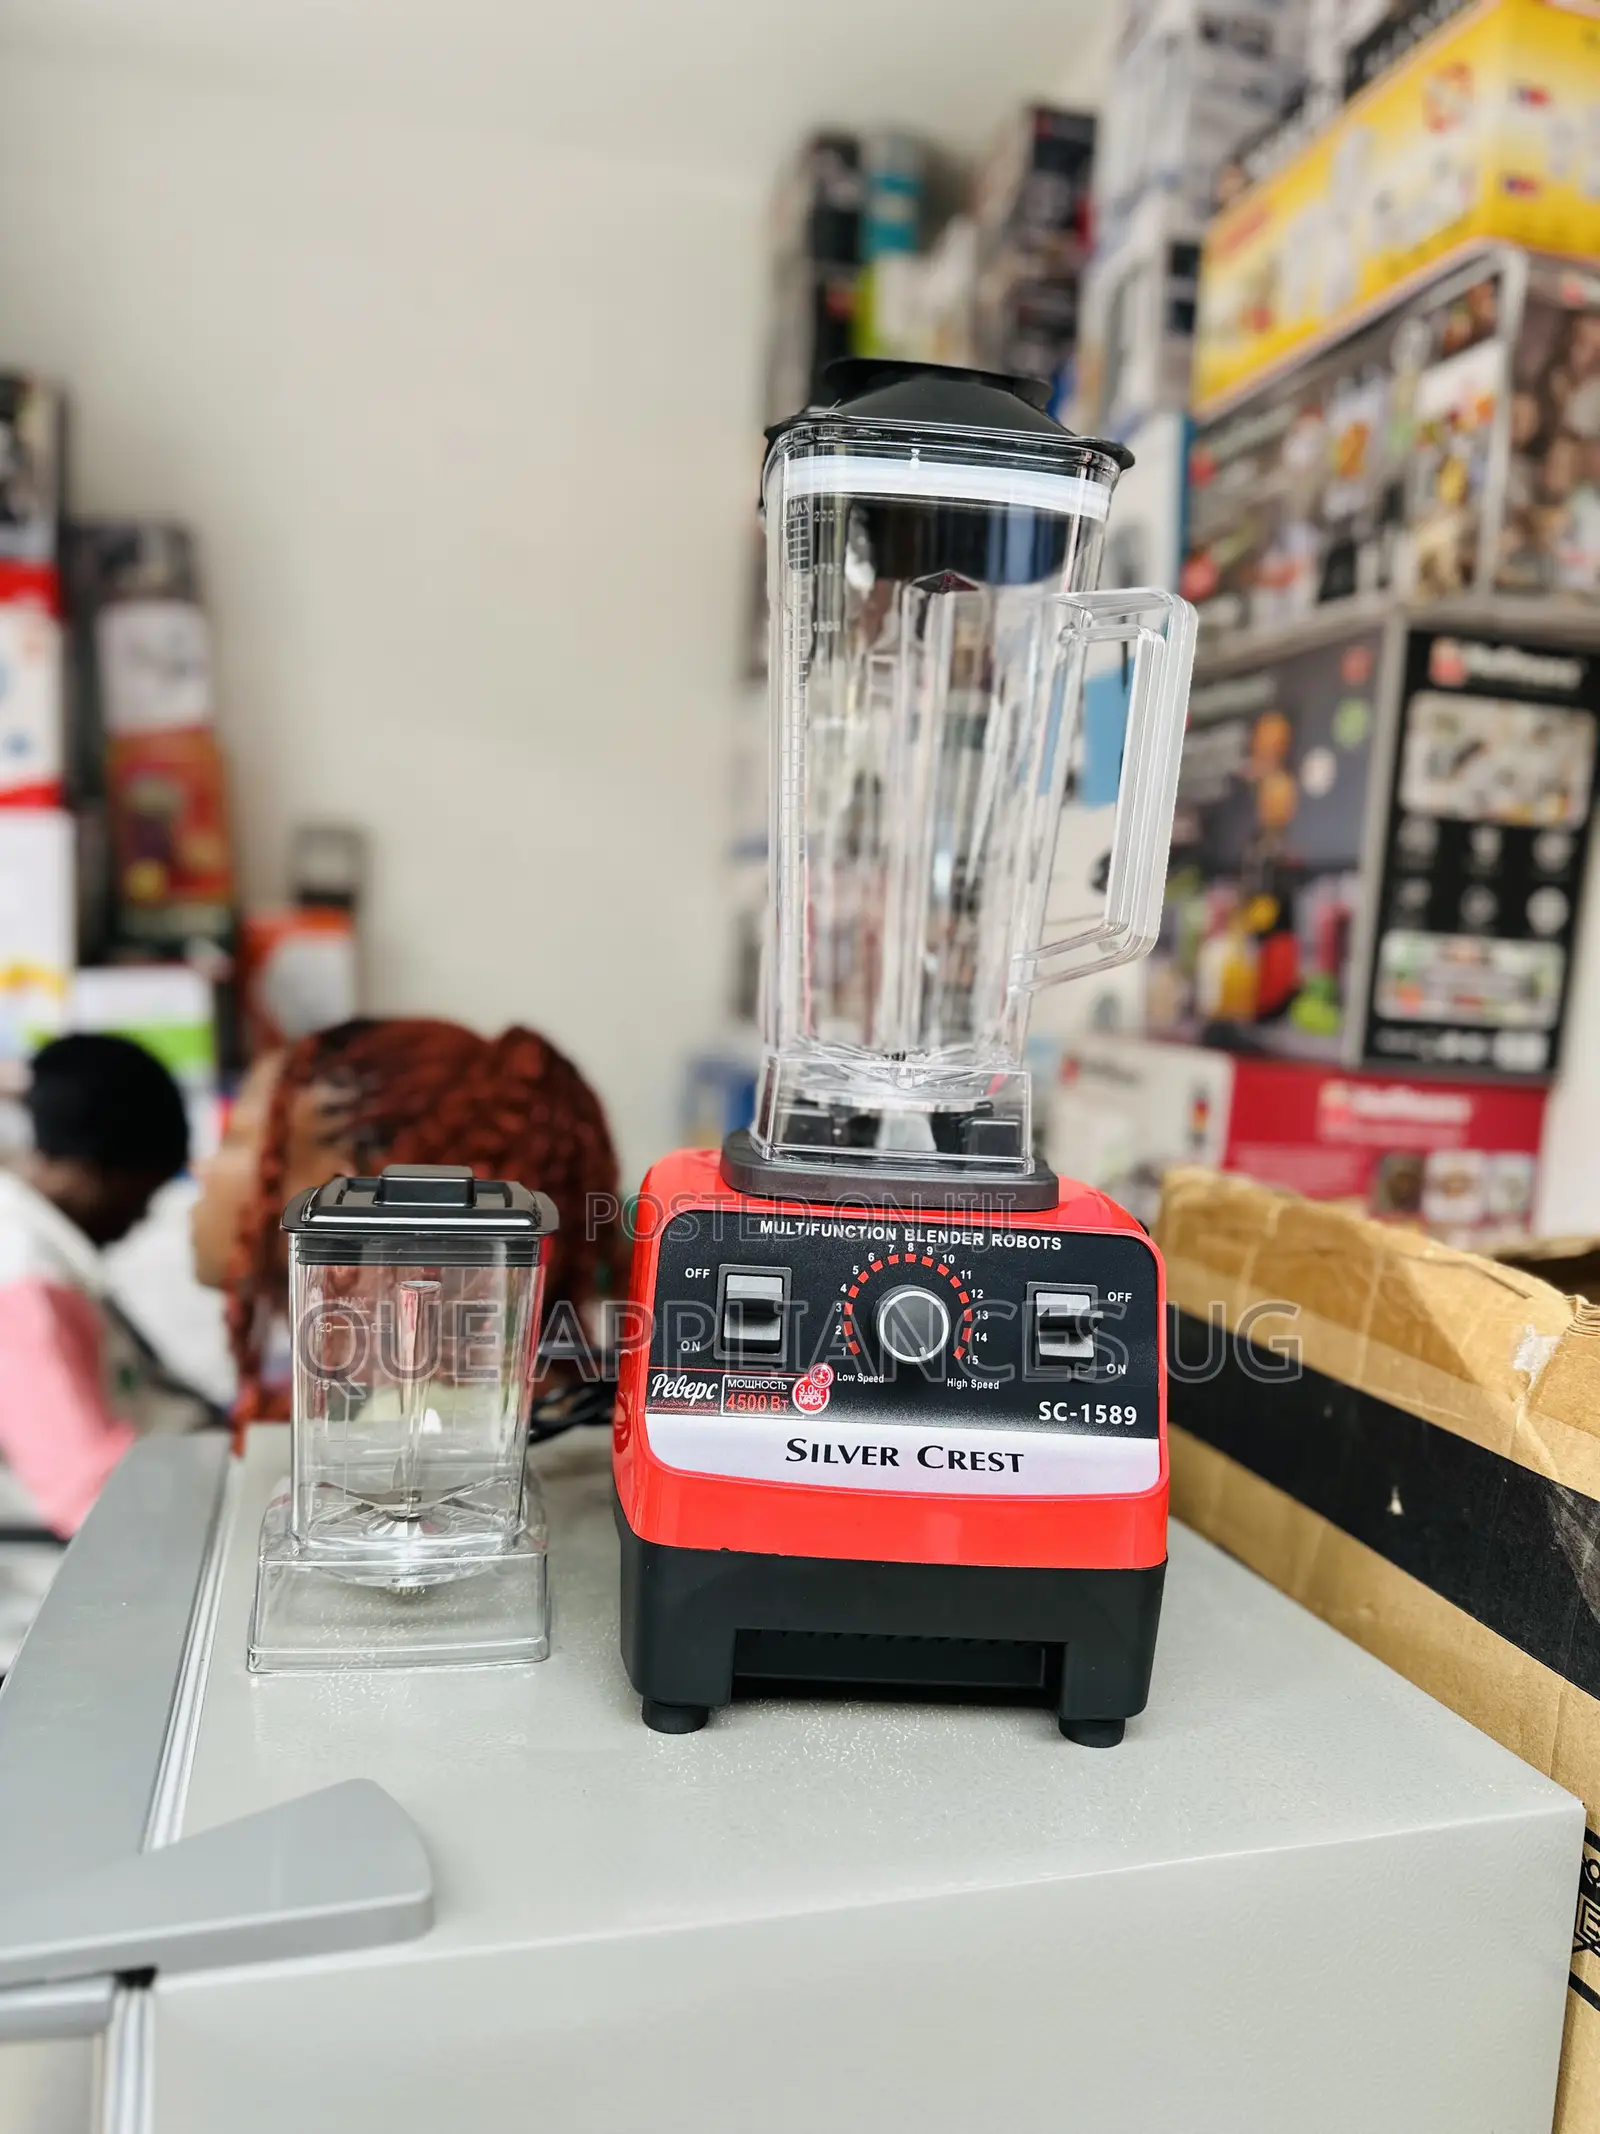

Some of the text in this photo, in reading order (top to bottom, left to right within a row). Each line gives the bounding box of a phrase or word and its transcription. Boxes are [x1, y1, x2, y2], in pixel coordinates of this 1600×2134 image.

[759, 1220, 1062, 1251] MULTIFUNCTION BLENDER ROBOTS
[888, 1245, 895, 1254] 7
[908, 1243, 914, 1252] 8
[927, 1246, 933, 1256] 9
[868, 1253, 875, 1262] 6
[943, 1254, 955, 1264] 10
[685, 1267, 711, 1279] OFF
[852, 1266, 859, 1275] 5
[960, 1270, 972, 1280] 11
[840, 1284, 847, 1293] 4
[971, 1289, 984, 1299] 12
[1107, 1291, 1132, 1303] OFF
[835, 1303, 842, 1312] 3
[976, 1310, 989, 1320] 13
[835, 1325, 842, 1335] 2
[975, 1332, 988, 1342] 14
[680, 1340, 701, 1352] ON
[841, 1346, 847, 1356] 1
[966, 1355, 979, 1365] 15
[1106, 1363, 1127, 1375] ON
[836, 1371, 885, 1384] Low Speed
[727, 1378, 788, 1391] МОЩНОСТЬ
[946, 1378, 1000, 1391] High Speed
[652, 1373, 719, 1407] Реверс
[726, 1392, 769, 1412] 4500
[1037, 1400, 1138, 1427] SC-1589
[784, 1437, 1025, 1474] SILVER CREST
